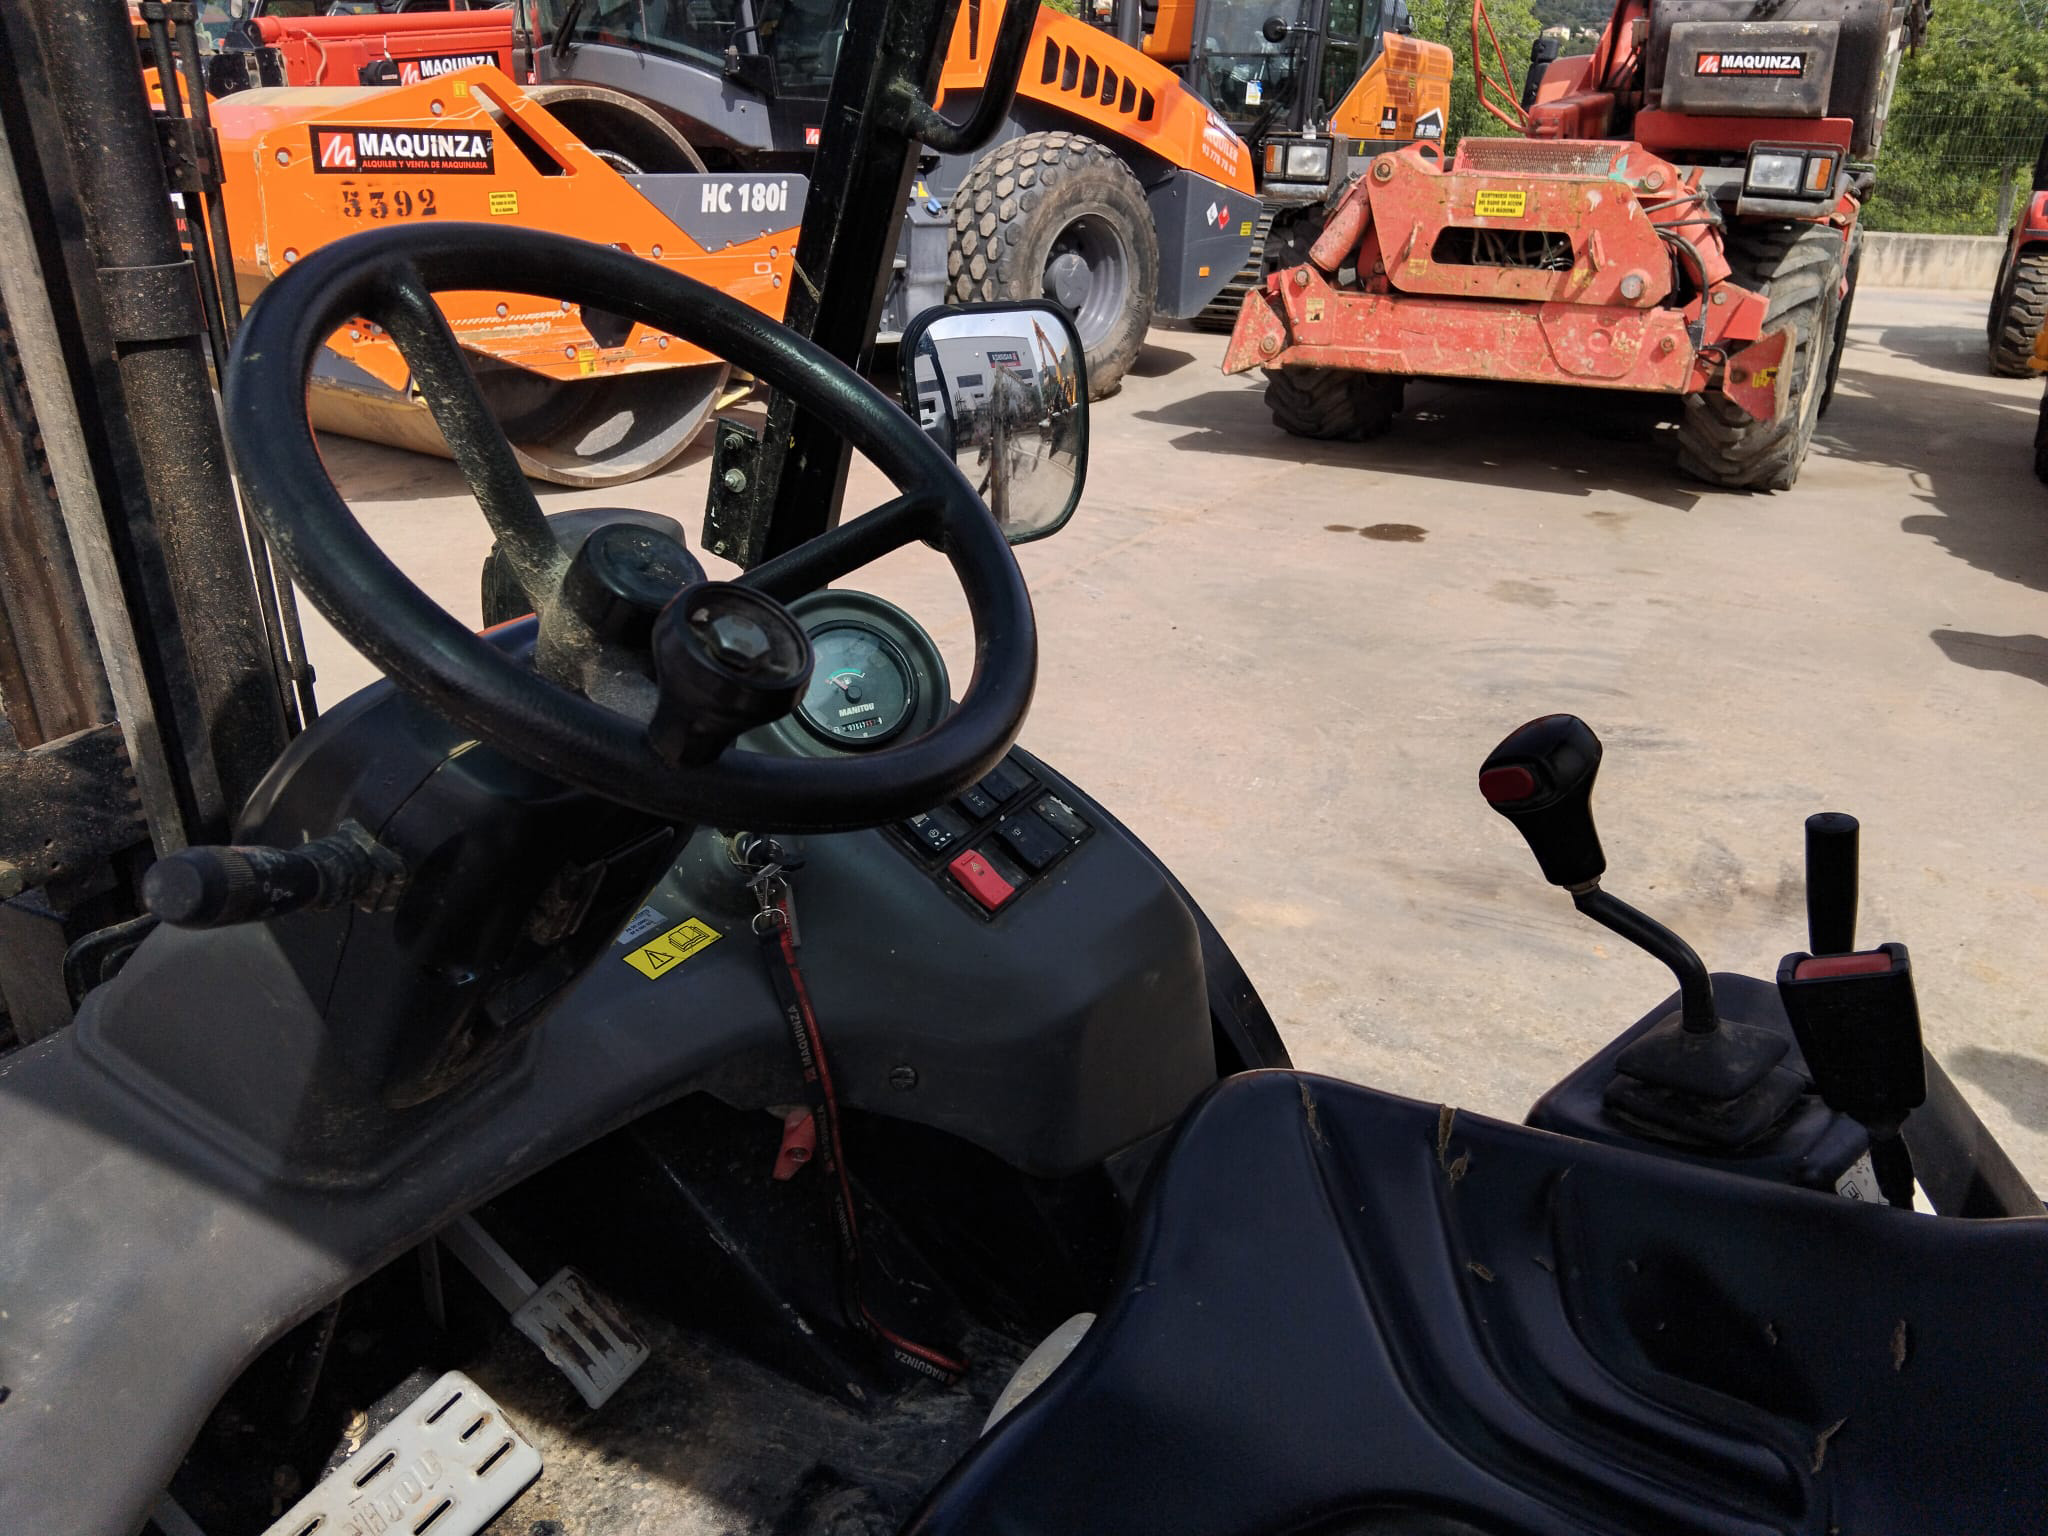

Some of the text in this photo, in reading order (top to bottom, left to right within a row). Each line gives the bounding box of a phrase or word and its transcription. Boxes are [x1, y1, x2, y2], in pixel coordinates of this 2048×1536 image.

[1721, 55, 1801, 69] MAQUINZA
[358, 132, 488, 158] MAQUINZA
[362, 160, 397, 168] ALQUILER
[406, 161, 430, 169] VENTA
[442, 161, 488, 169] MAQUINARIA
[342, 189, 437, 219] 5392
[701, 180, 788, 213] HC 180i
[838, 702, 875, 718] MANITOU
[788, 1003, 815, 1066] MAQUINZA
[894, 1348, 948, 1382] MAQUINZA
